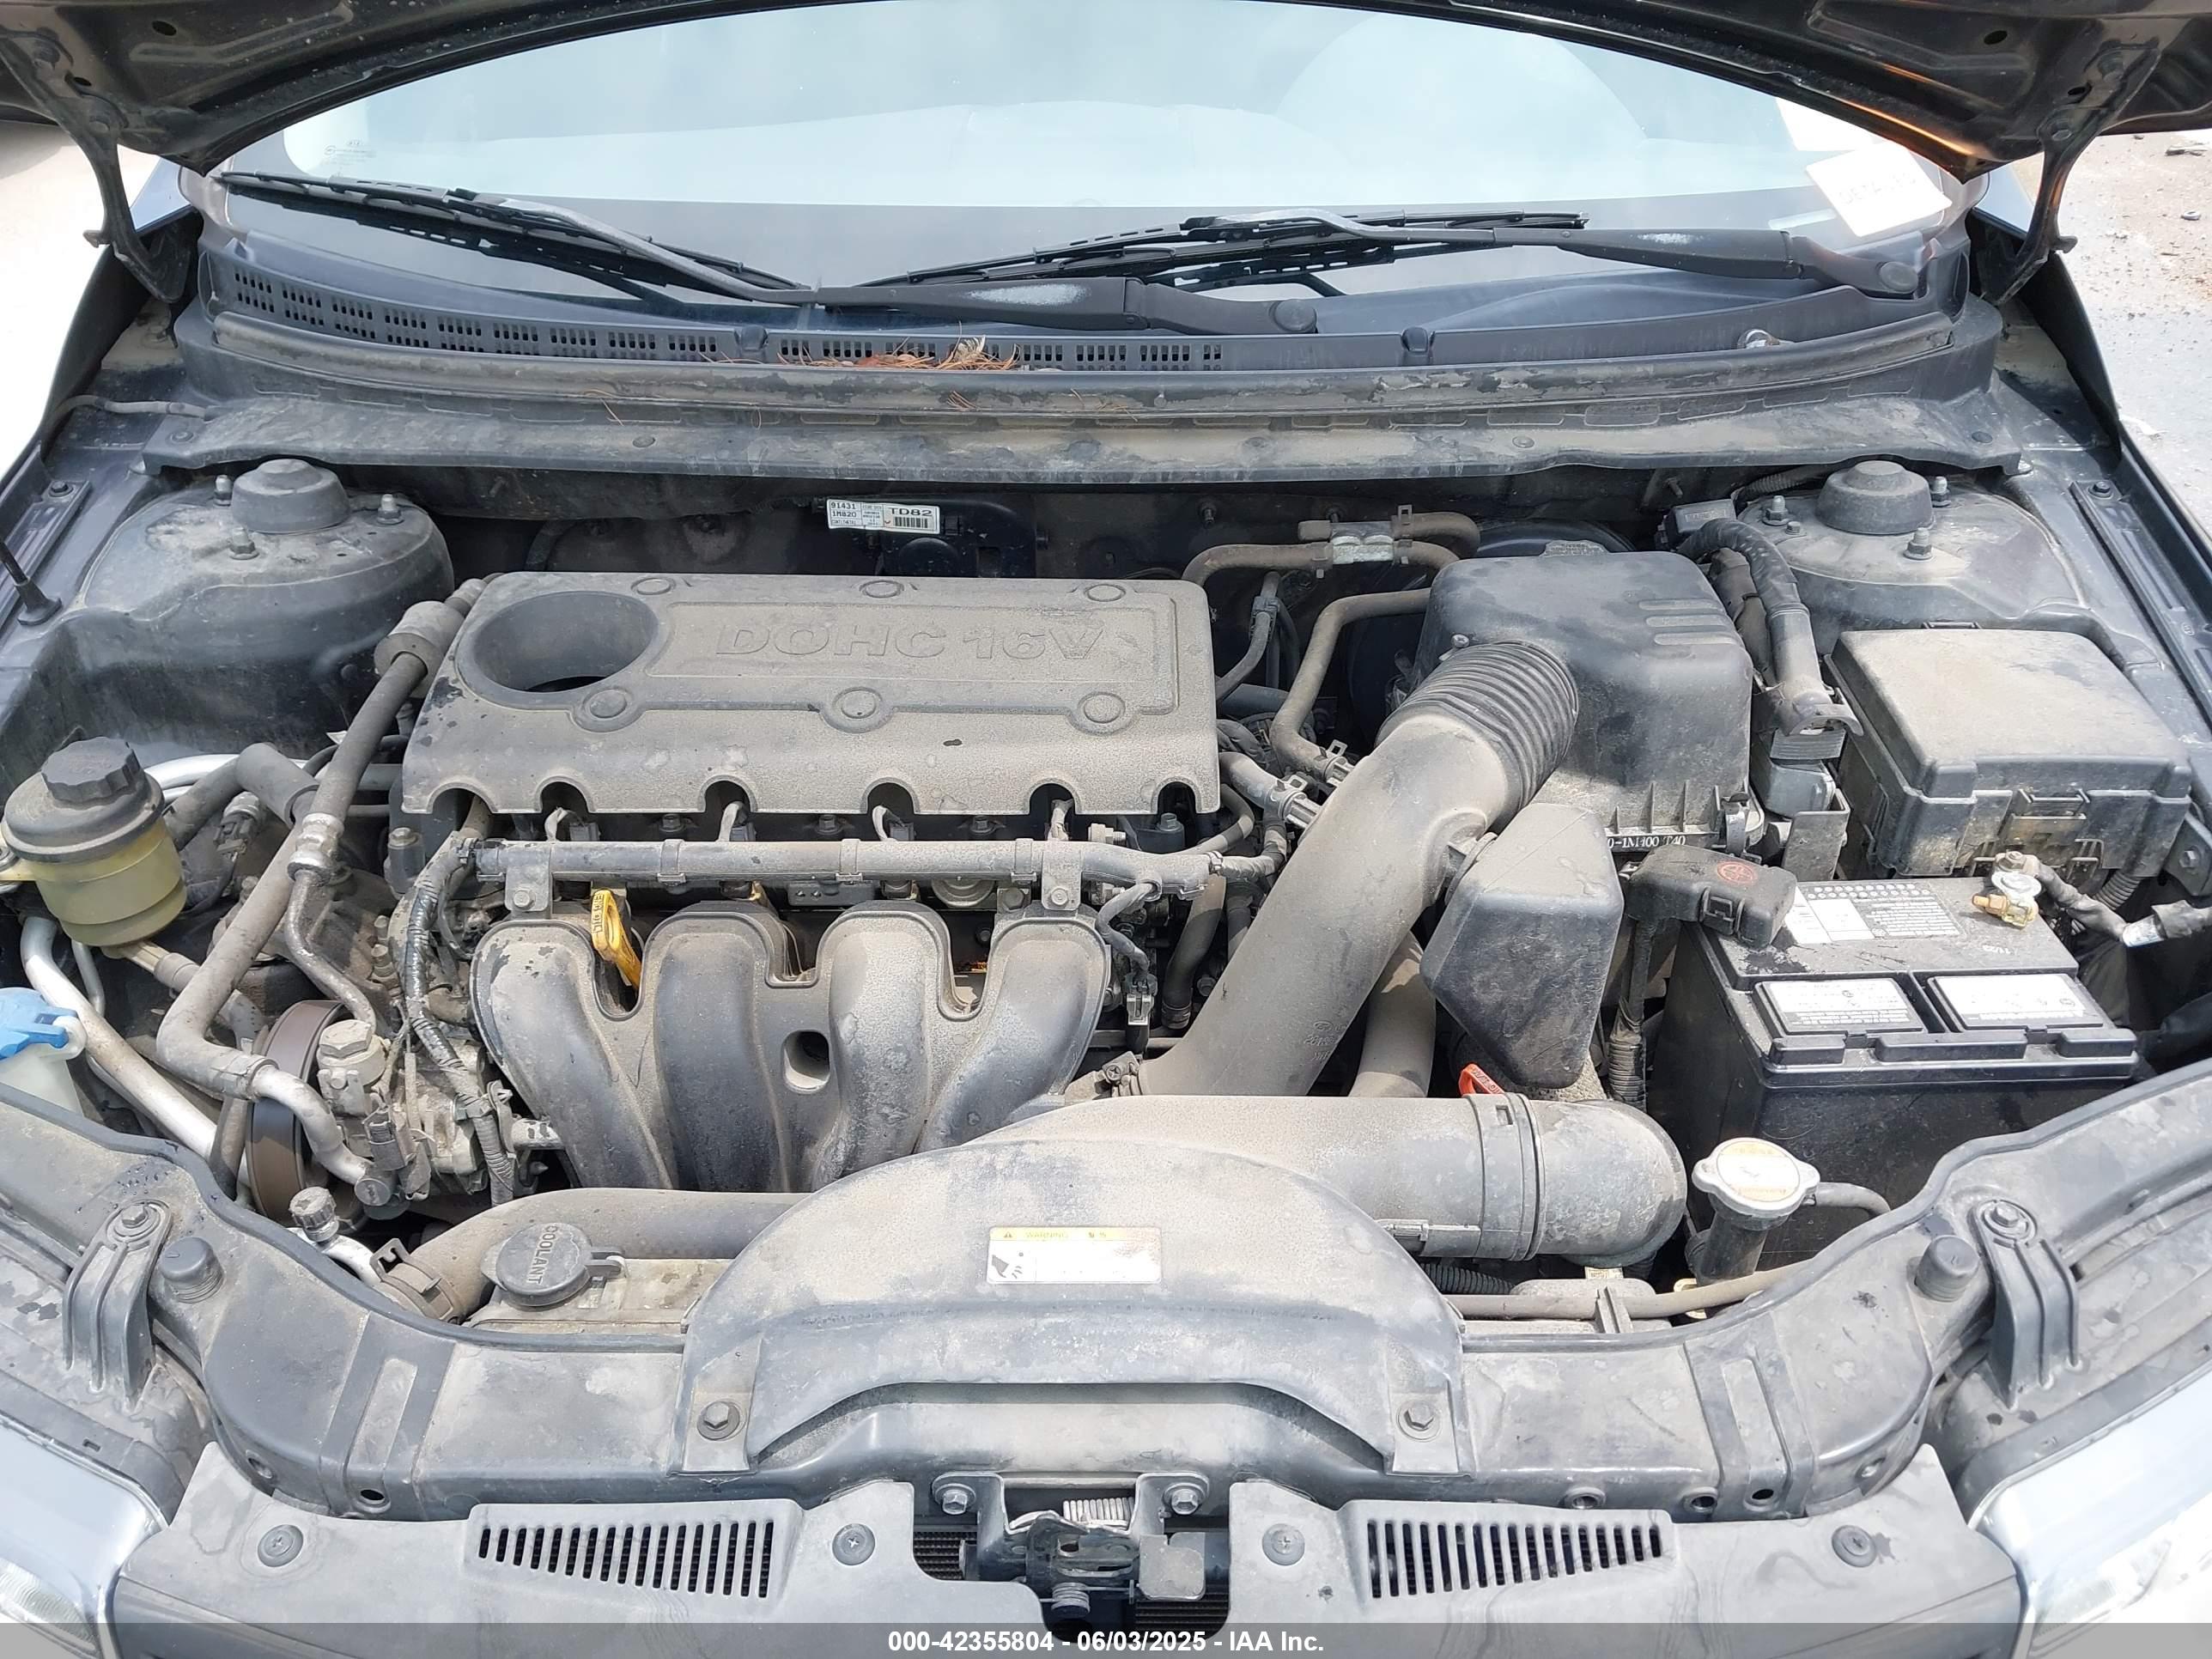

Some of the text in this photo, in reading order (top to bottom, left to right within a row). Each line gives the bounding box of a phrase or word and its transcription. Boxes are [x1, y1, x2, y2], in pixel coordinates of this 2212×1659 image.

[888, 507, 933, 517] TD82
[715, 624, 1104, 660] DOHC 16V
[526, 1224, 560, 1285] COOLANT
